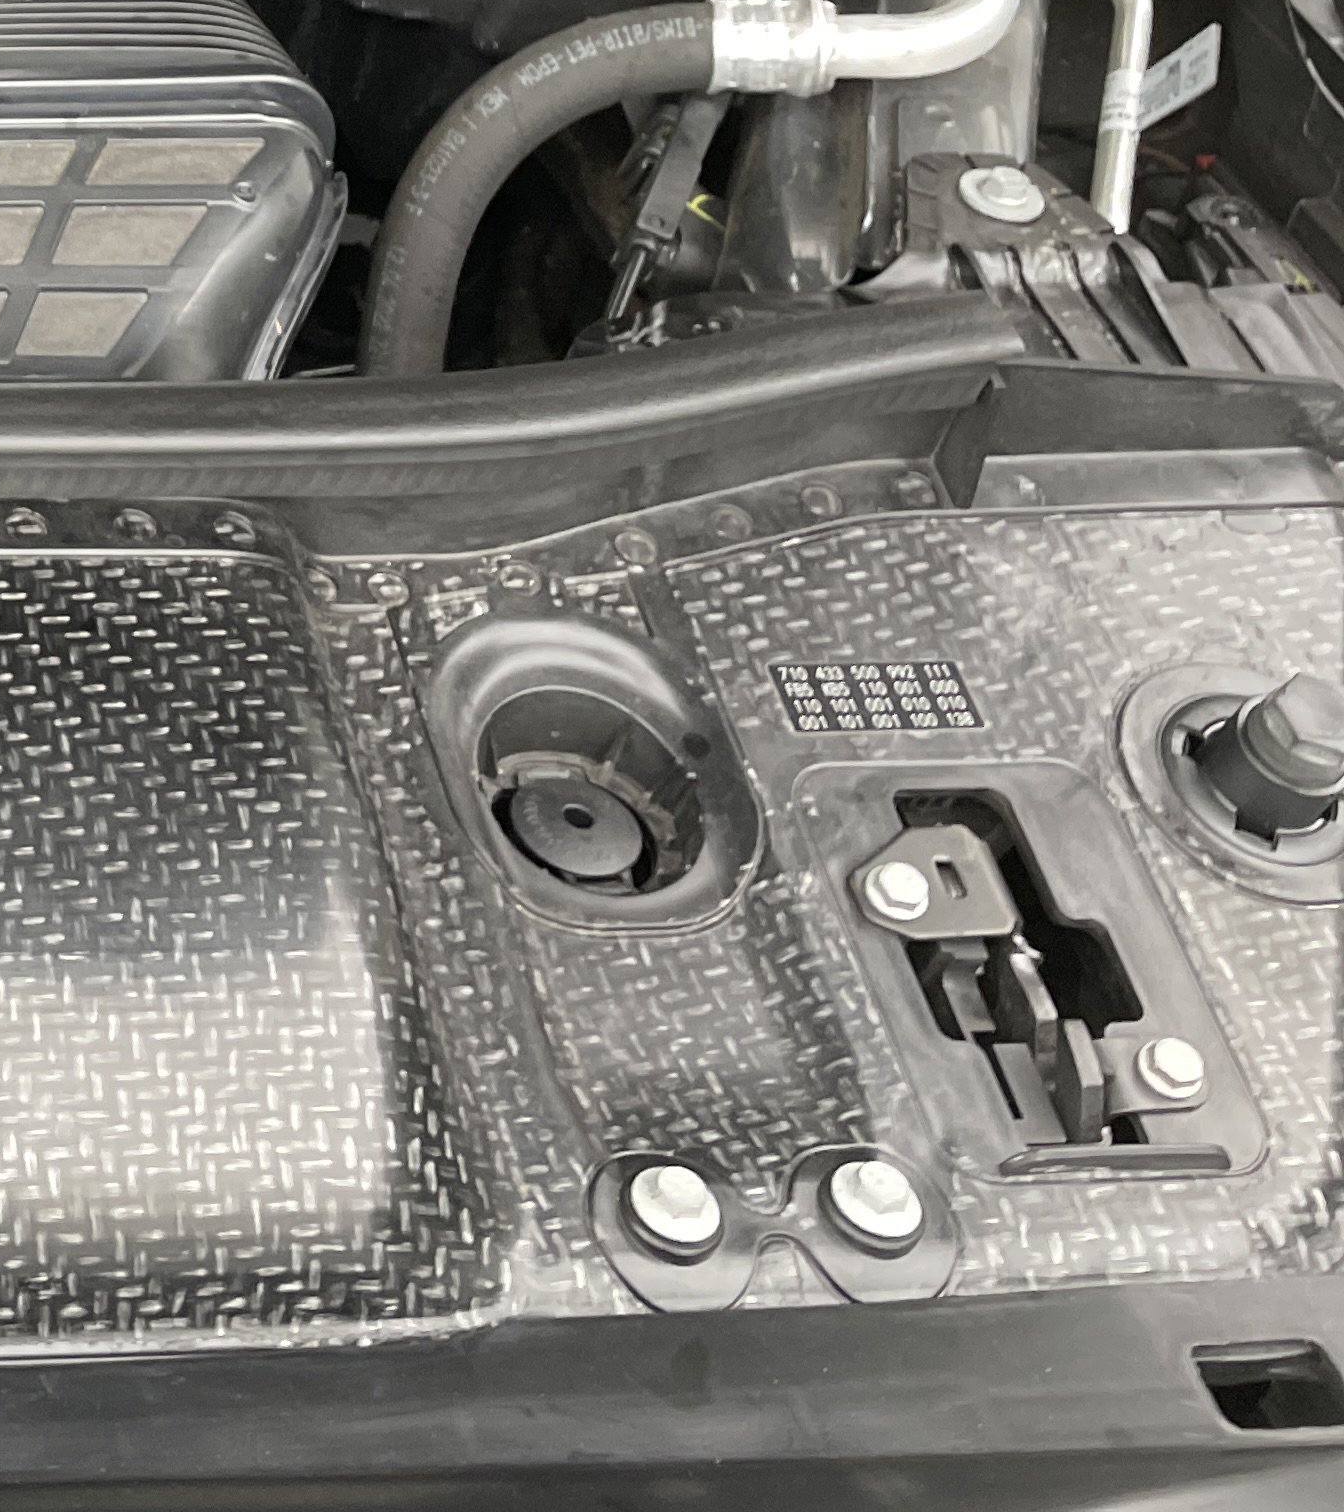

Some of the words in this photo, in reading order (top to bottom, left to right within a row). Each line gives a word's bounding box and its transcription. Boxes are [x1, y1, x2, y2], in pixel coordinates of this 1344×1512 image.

[777, 666, 808, 681] 710
[924, 664, 951, 678] 111
[859, 681, 887, 695] 110
[894, 681, 922, 695] 001
[929, 679, 959, 694] 000
[794, 698, 822, 713] 110
[830, 698, 858, 712] 101
[864, 697, 894, 712] 001
[901, 697, 931, 711] 010
[937, 695, 967, 710] 010
[799, 715, 828, 730] 001
[837, 714, 865, 729] 101
[872, 714, 901, 728] 001
[910, 713, 938, 727] 100
